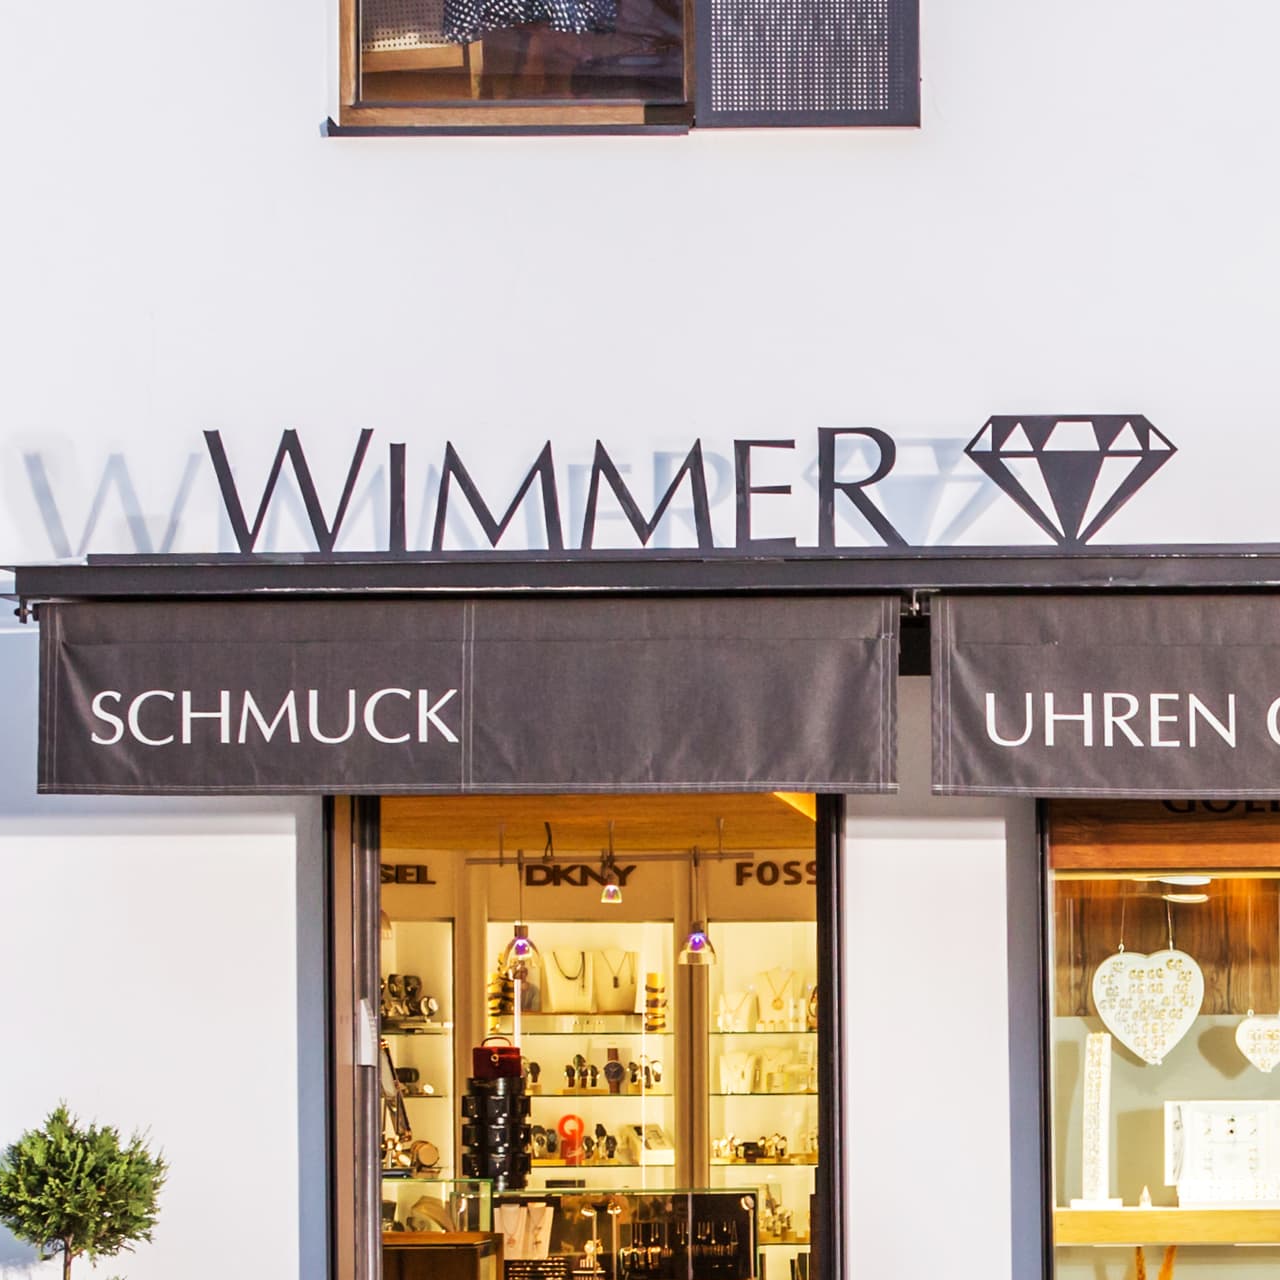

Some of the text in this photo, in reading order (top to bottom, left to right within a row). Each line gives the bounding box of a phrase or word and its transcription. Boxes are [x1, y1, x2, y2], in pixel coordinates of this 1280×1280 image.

[204, 428, 909, 553] WIMMER
[91, 689, 459, 746] SCHMUCK
[985, 692, 1236, 748] UHREN
[525, 864, 637, 887] DKNY
